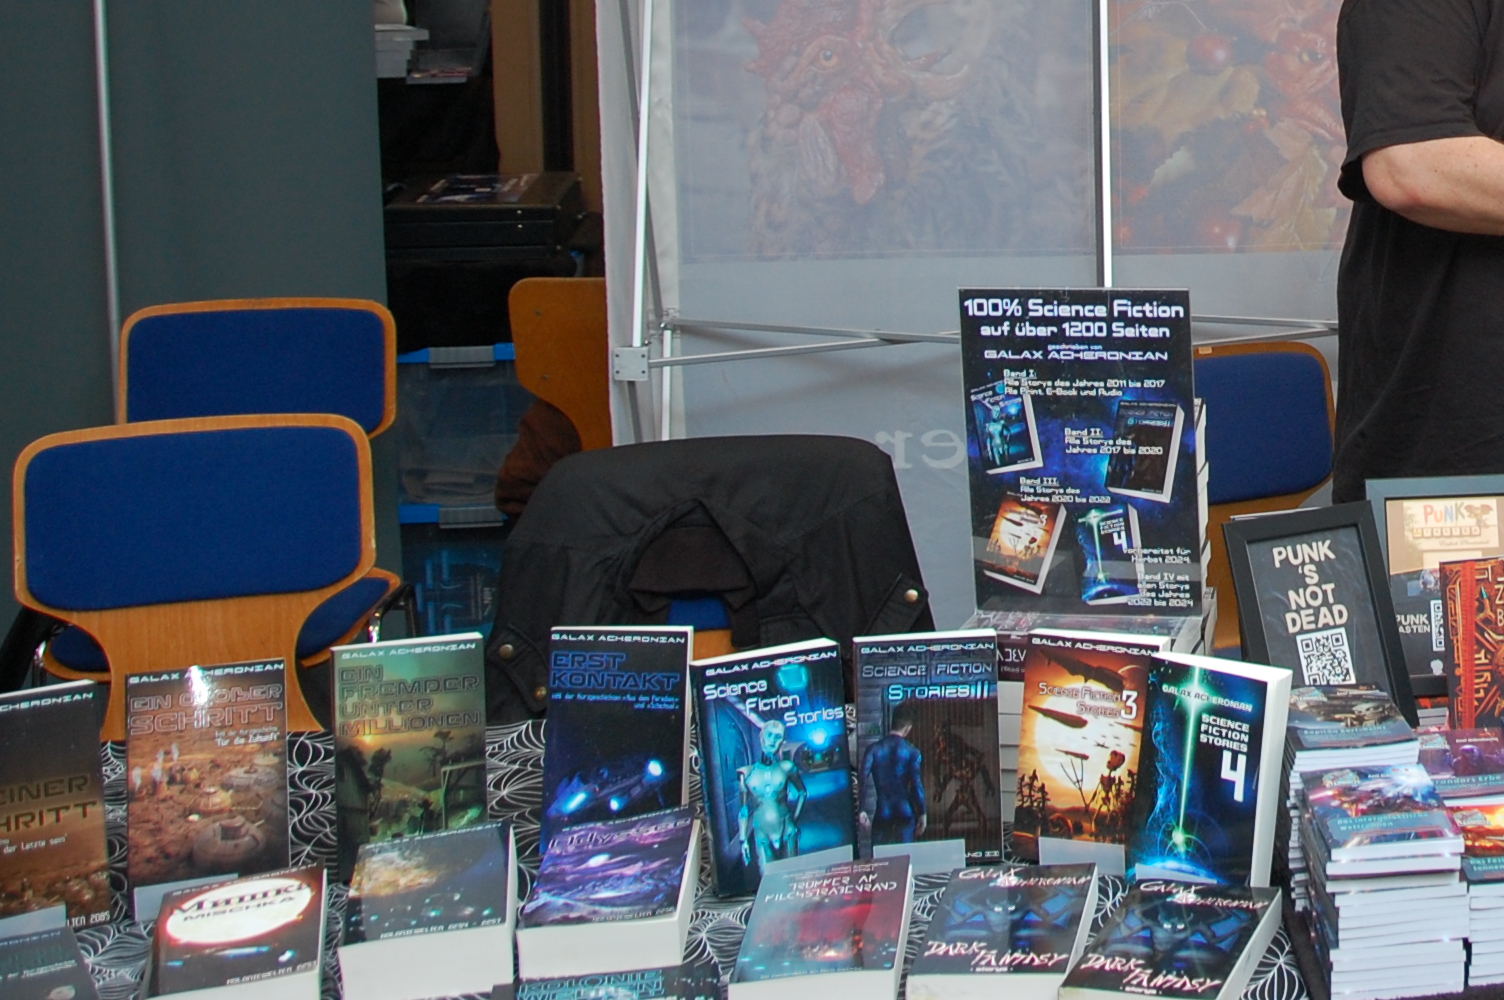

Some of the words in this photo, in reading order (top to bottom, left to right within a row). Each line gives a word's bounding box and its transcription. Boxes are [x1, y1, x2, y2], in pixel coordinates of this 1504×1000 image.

[963, 298, 1022, 317] 100%
[1028, 298, 1108, 318] Science
[1113, 299, 1184, 319] Fiction
[980, 320, 1010, 337] auf
[1015, 320, 1057, 338] über
[1062, 321, 1107, 338] 1200
[1112, 322, 1170, 338] Seiten
[984, 349, 1043, 360] GALAX
[1047, 350, 1169, 361] ACHERONIAN
[1272, 539, 1337, 569] PUNK
[1287, 582, 1337, 612] NOT
[1285, 604, 1349, 635] DEAD
[1398, 624, 1431, 634] ASTEN
[551, 633, 595, 641] GALAX
[598, 634, 685, 644] ACHERONIAN
[860, 646, 904, 655] GALAX
[907, 642, 995, 653] ACHERONIAN
[1031, 637, 1073, 649] GALAX
[550, 650, 626, 671] ERST
[704, 664, 749, 677] GALAX
[751, 650, 838, 669] ACHERONIAN
[862, 663, 927, 678] SCIENCE
[936, 662, 993, 676] FICTION
[129, 672, 181, 685] GALAX
[338, 664, 384, 685] EIN
[550, 670, 680, 691] KONTAKT
[338, 674, 481, 703] FREMDER
[0, 692, 94, 711] CHERONIAN
[130, 694, 173, 713] EIN
[338, 698, 433, 720] UNTER
[1120, 689, 1139, 720] 3
[130, 701, 284, 737] SCHRITT
[338, 710, 481, 738] MILLIONEN
[1201, 713, 1250, 733] SCIENCE
[1199, 733, 1249, 753] STORIES
[1200, 723, 1250, 743] FICTION
[1220, 749, 1248, 803] 4
[923, 940, 988, 957] DARK
[970, 947, 1070, 967] FANTASY
[1079, 952, 1146, 971] DARK
[1122, 967, 1222, 993] FANTASY
